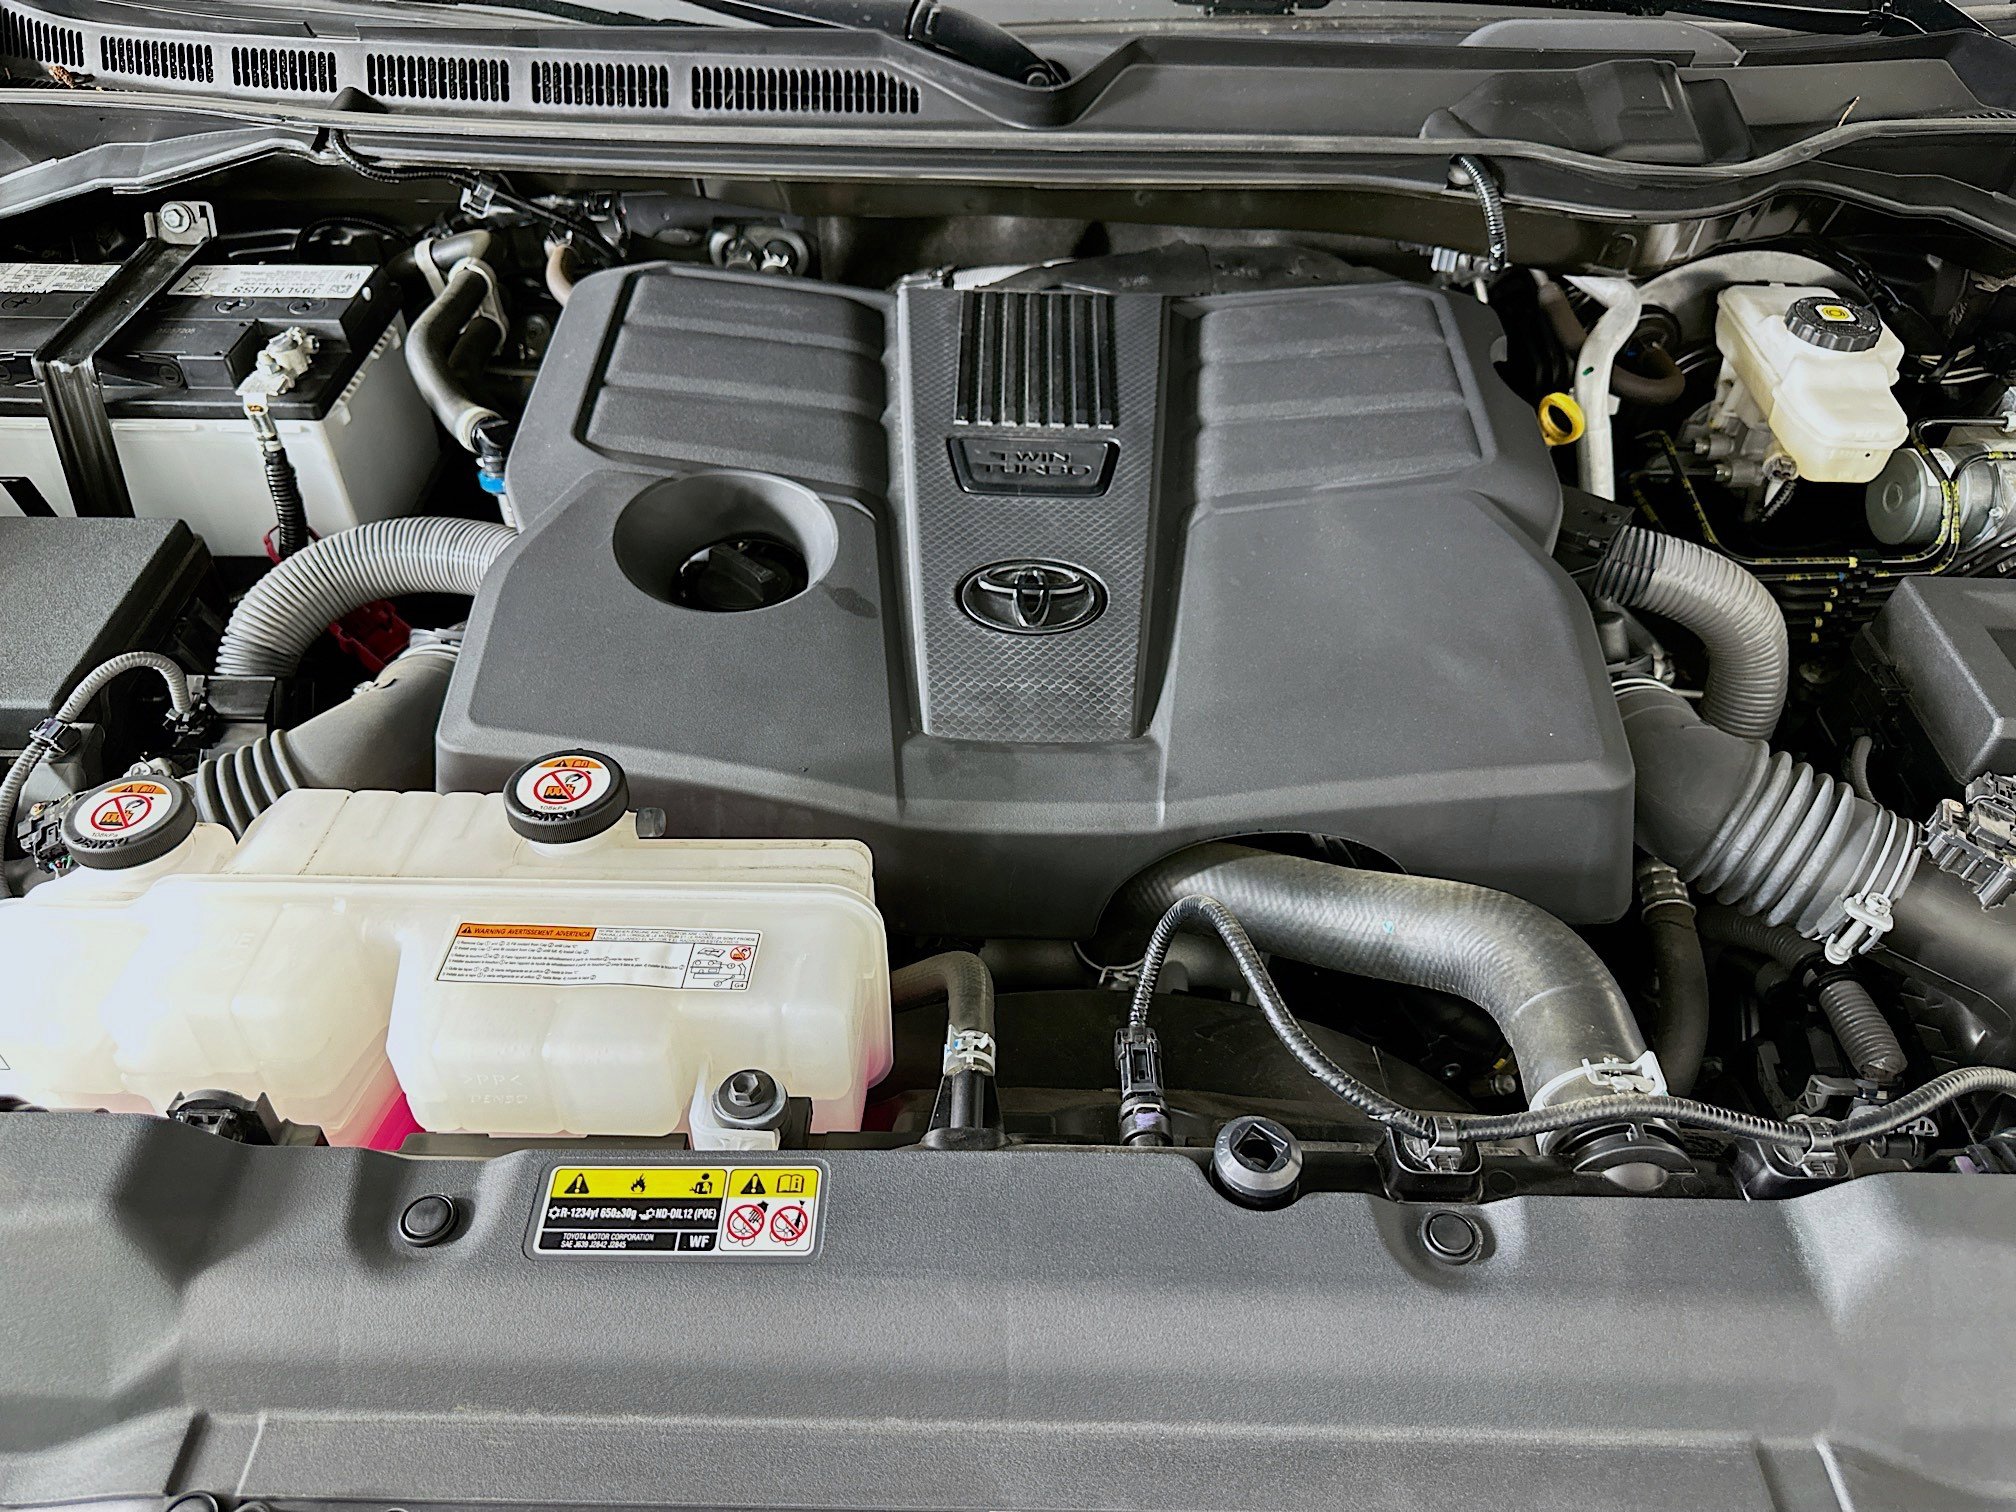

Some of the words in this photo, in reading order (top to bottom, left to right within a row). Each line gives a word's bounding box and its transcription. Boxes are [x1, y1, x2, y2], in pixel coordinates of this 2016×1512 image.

[989, 450, 1072, 463] TWIN
[974, 463, 1092, 476] TURBO
[473, 927, 506, 936] WARNING
[507, 928, 554, 937] AVERTISSEMENT
[555, 929, 591, 938] ADVERTENCIA
[560, 1207, 600, 1220] R-1234yf
[600, 1208, 637, 1221] 650±30g
[694, 1208, 717, 1221] (POE)
[560, 1240, 573, 1248] SAE
[563, 1233, 587, 1241] TOYOTA
[588, 1233, 610, 1241] MOTOR
[610, 1233, 655, 1242] CORPORATION
[689, 1235, 710, 1248] WF
